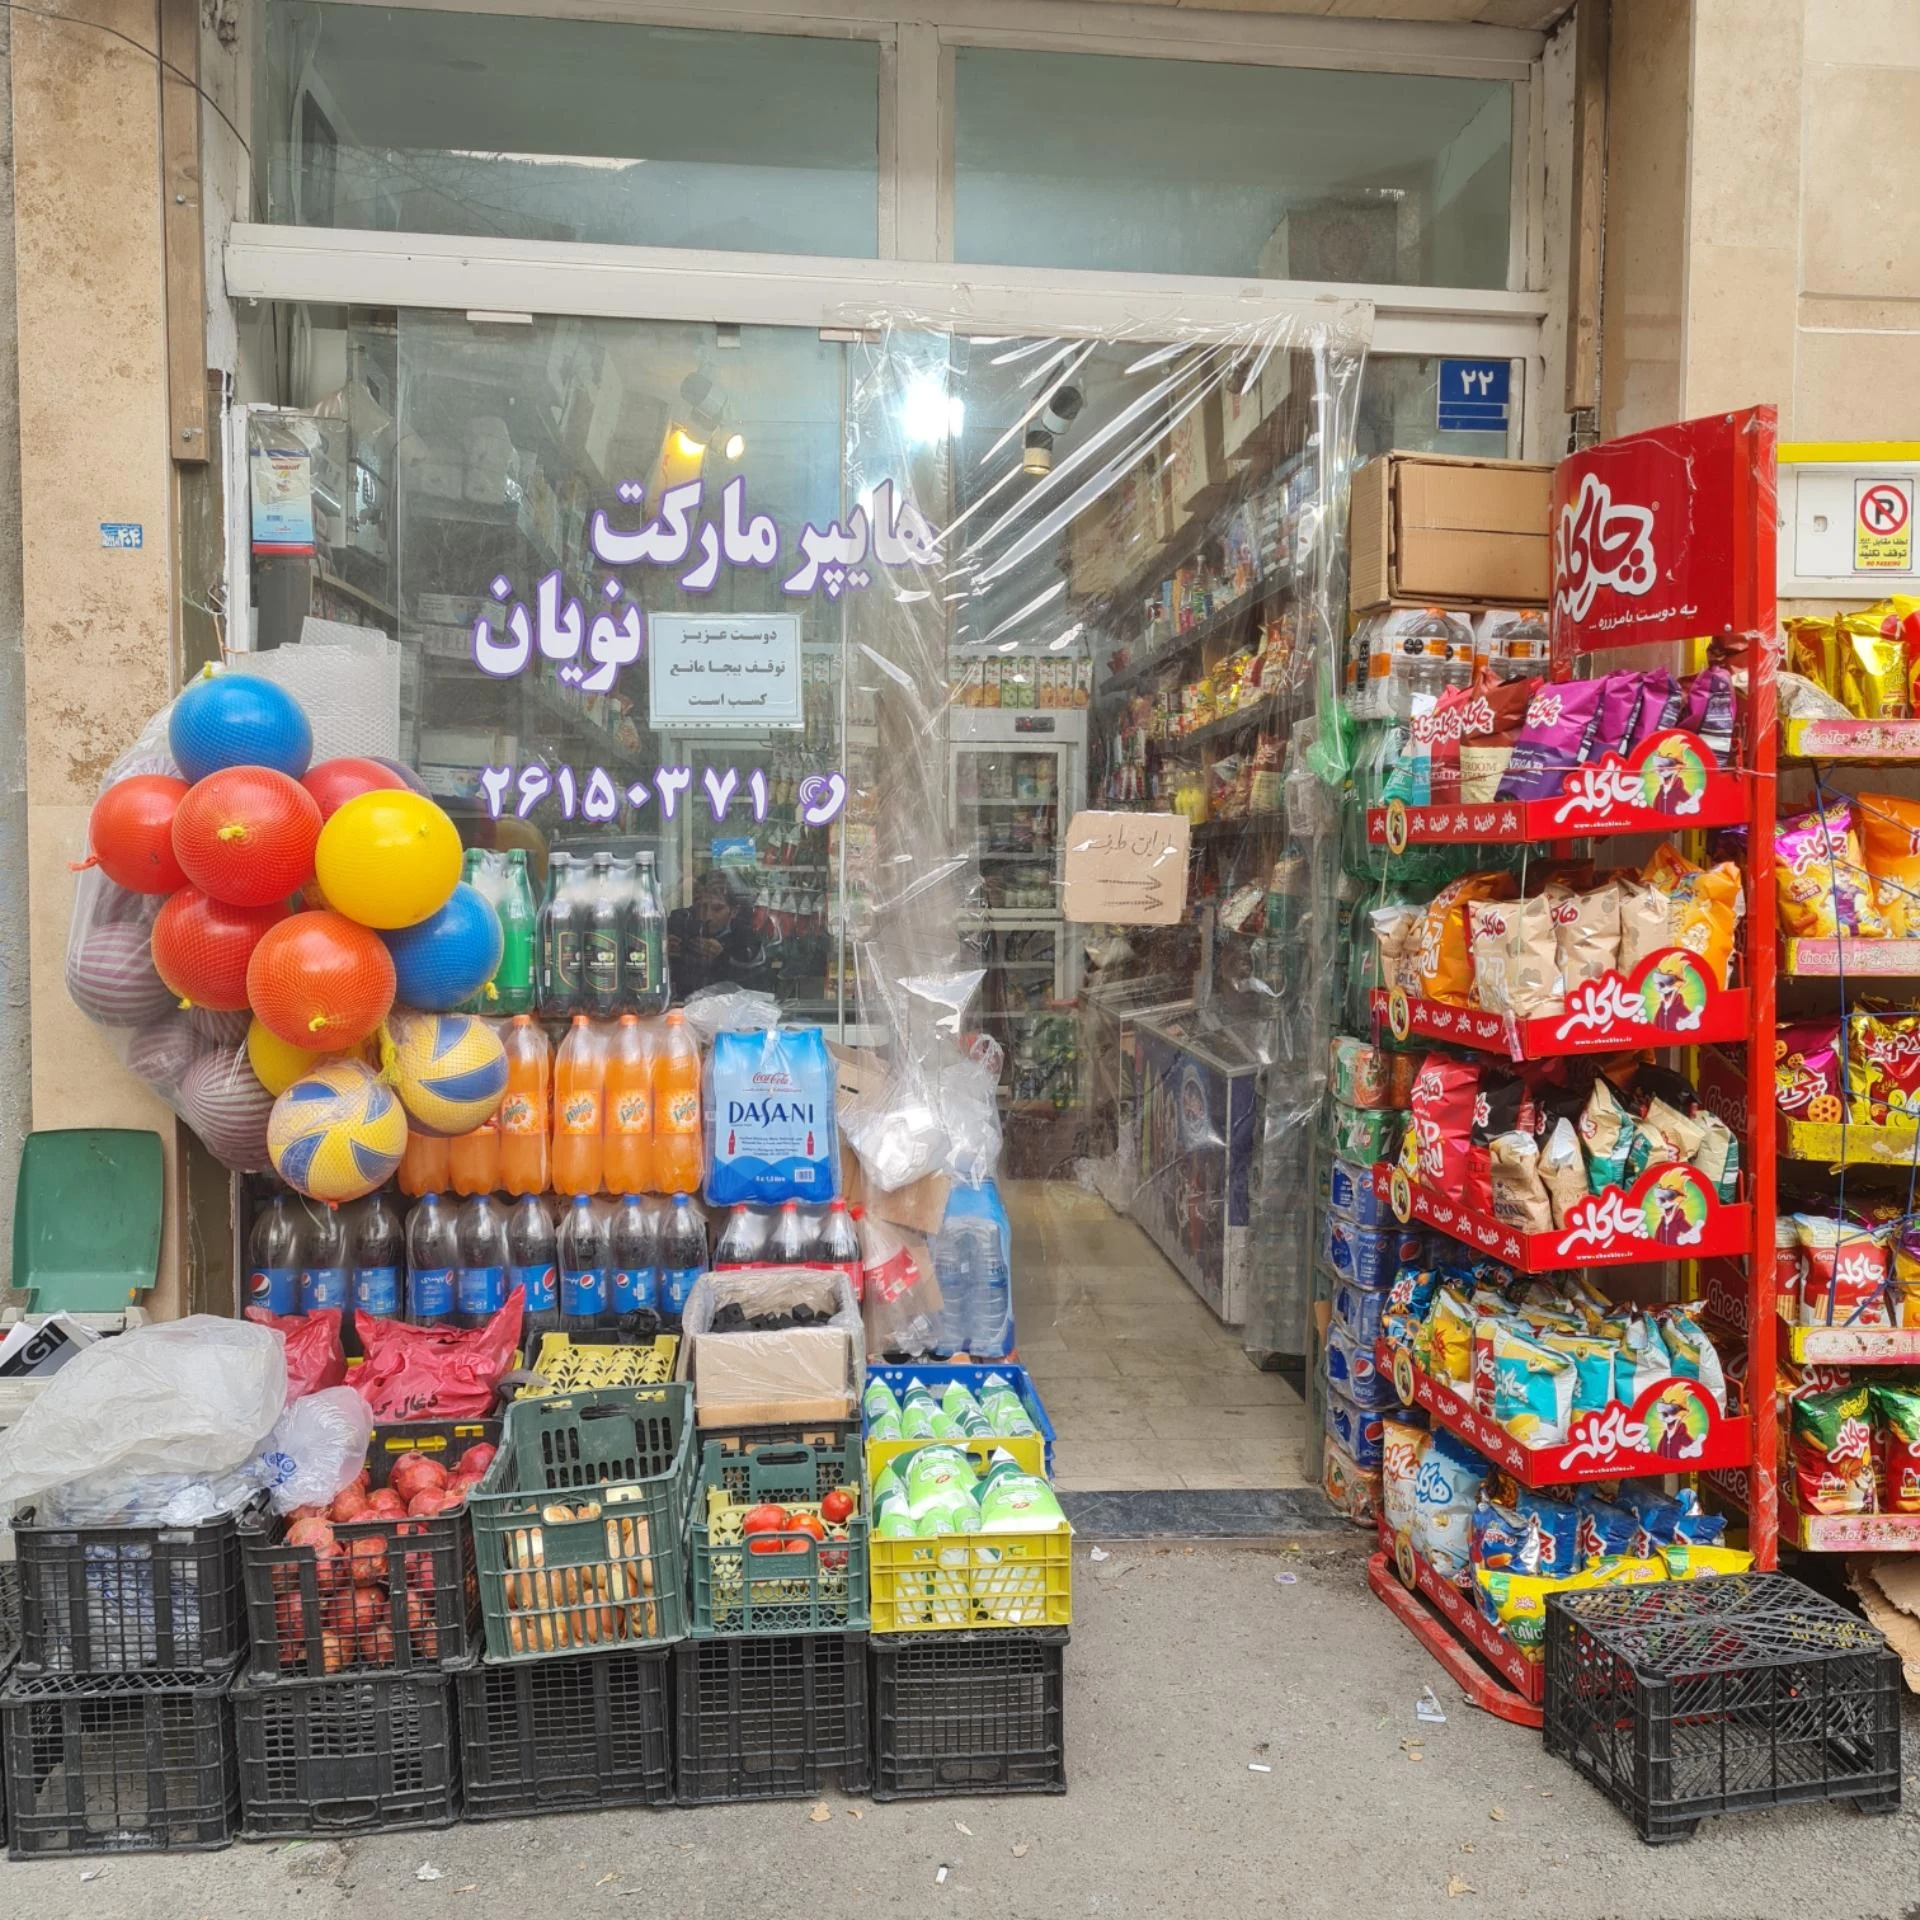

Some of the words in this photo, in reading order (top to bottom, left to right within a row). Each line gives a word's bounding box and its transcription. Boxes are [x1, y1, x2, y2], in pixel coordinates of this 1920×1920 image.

[1461, 369, 1494, 396] ۲۲
[592, 475, 781, 590] مارکت
[782, 477, 945, 599] هایپر
[1636, 606, 1677, 622] دوست
[473, 571, 645, 692] نویان
[681, 630, 727, 644] عزیز
[730, 630, 777, 644] دوست
[670, 660, 705, 676] مانع
[708, 660, 742, 676] بیجا
[745, 660, 785, 677] توقف
[688, 693, 725, 706] است
[728, 693, 767, 709] کسب
[480, 764, 769, 823] ۲۶۱۵۰۳۷۱
[1554, 759, 1647, 823] چاکلز
[1794, 828, 1847, 874] چکلز
[1556, 977, 1648, 1040] چاکلز
[752, 1072, 792, 1085] Coca-Cola
[729, 1097, 814, 1128] DASANI
[1557, 1192, 1649, 1255] چاکلز
[21, 1328, 62, 1365] G1
[1560, 1407, 1651, 1470] چاکلز
